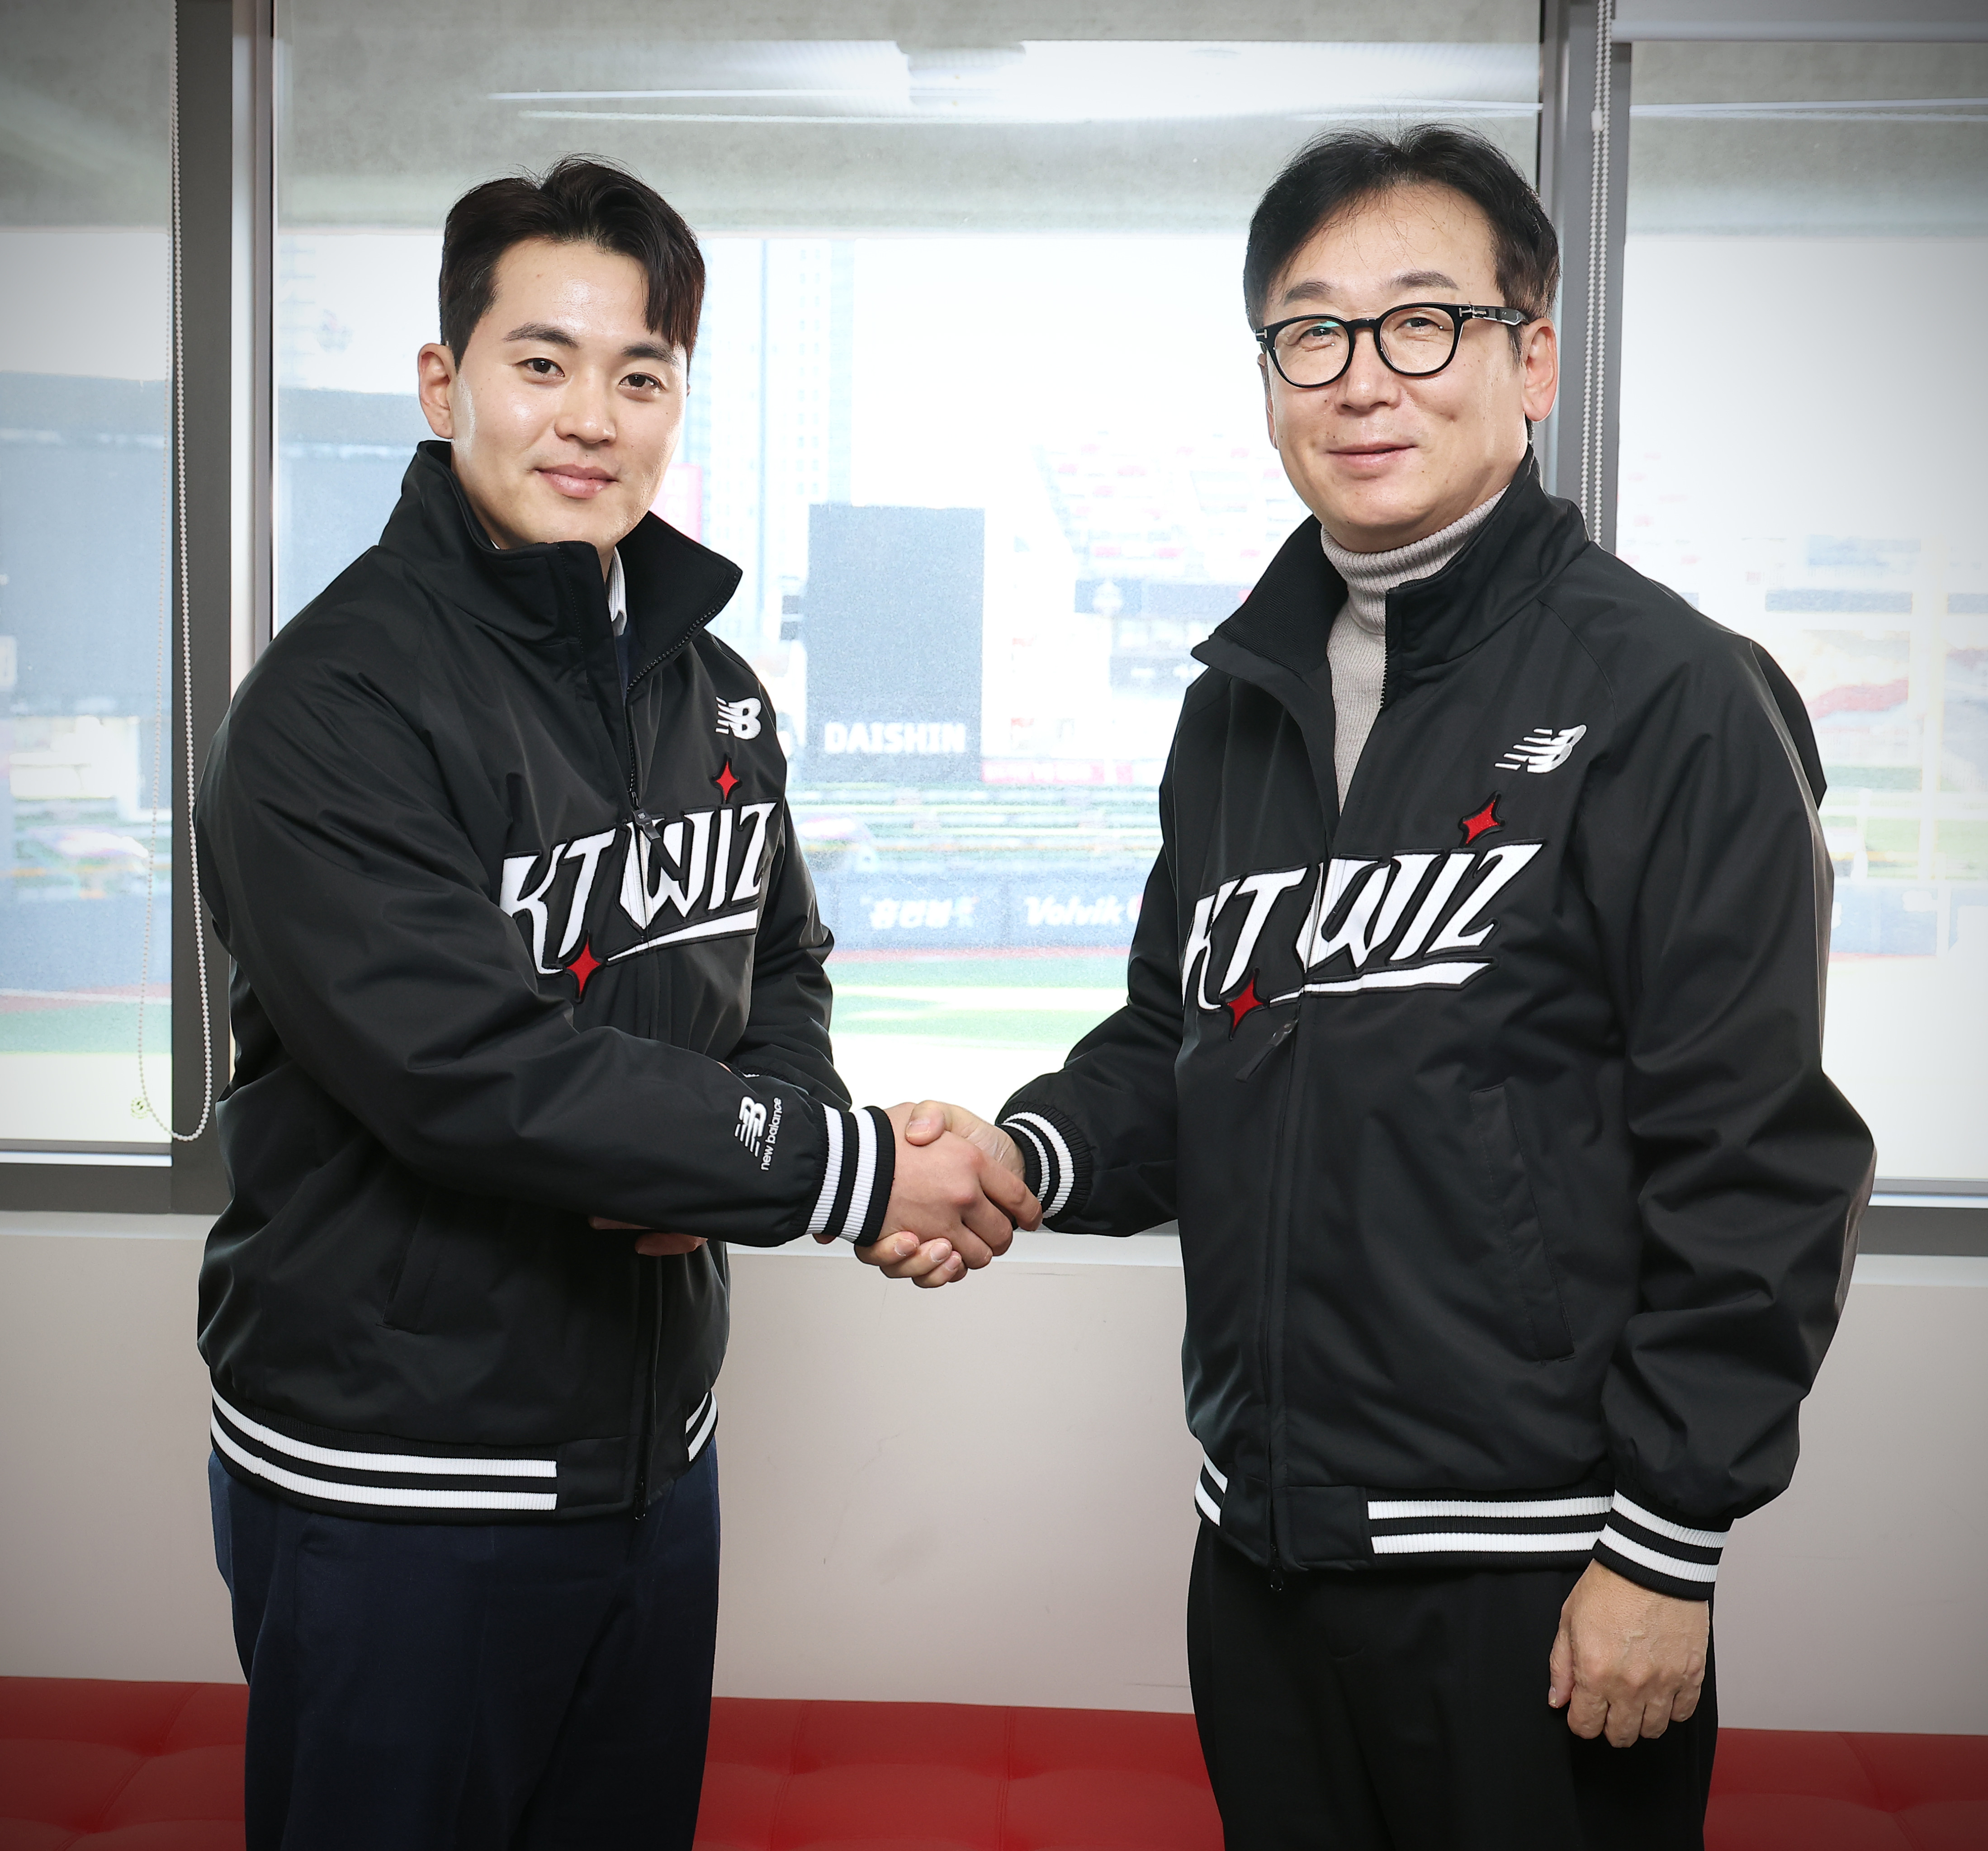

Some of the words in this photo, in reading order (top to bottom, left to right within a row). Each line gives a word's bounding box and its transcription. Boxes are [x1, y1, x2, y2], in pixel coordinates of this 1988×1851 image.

[824, 722, 966, 754] DAISHIN
[500, 828, 616, 974] KT
[620, 802, 777, 930] WIZ
[1024, 894, 1125, 926] Volvik
[1182, 867, 1308, 1010] KT
[1296, 844, 1543, 973] WIZ
[765, 1097, 782, 1145] balance
[761, 1145, 774, 1171] new
